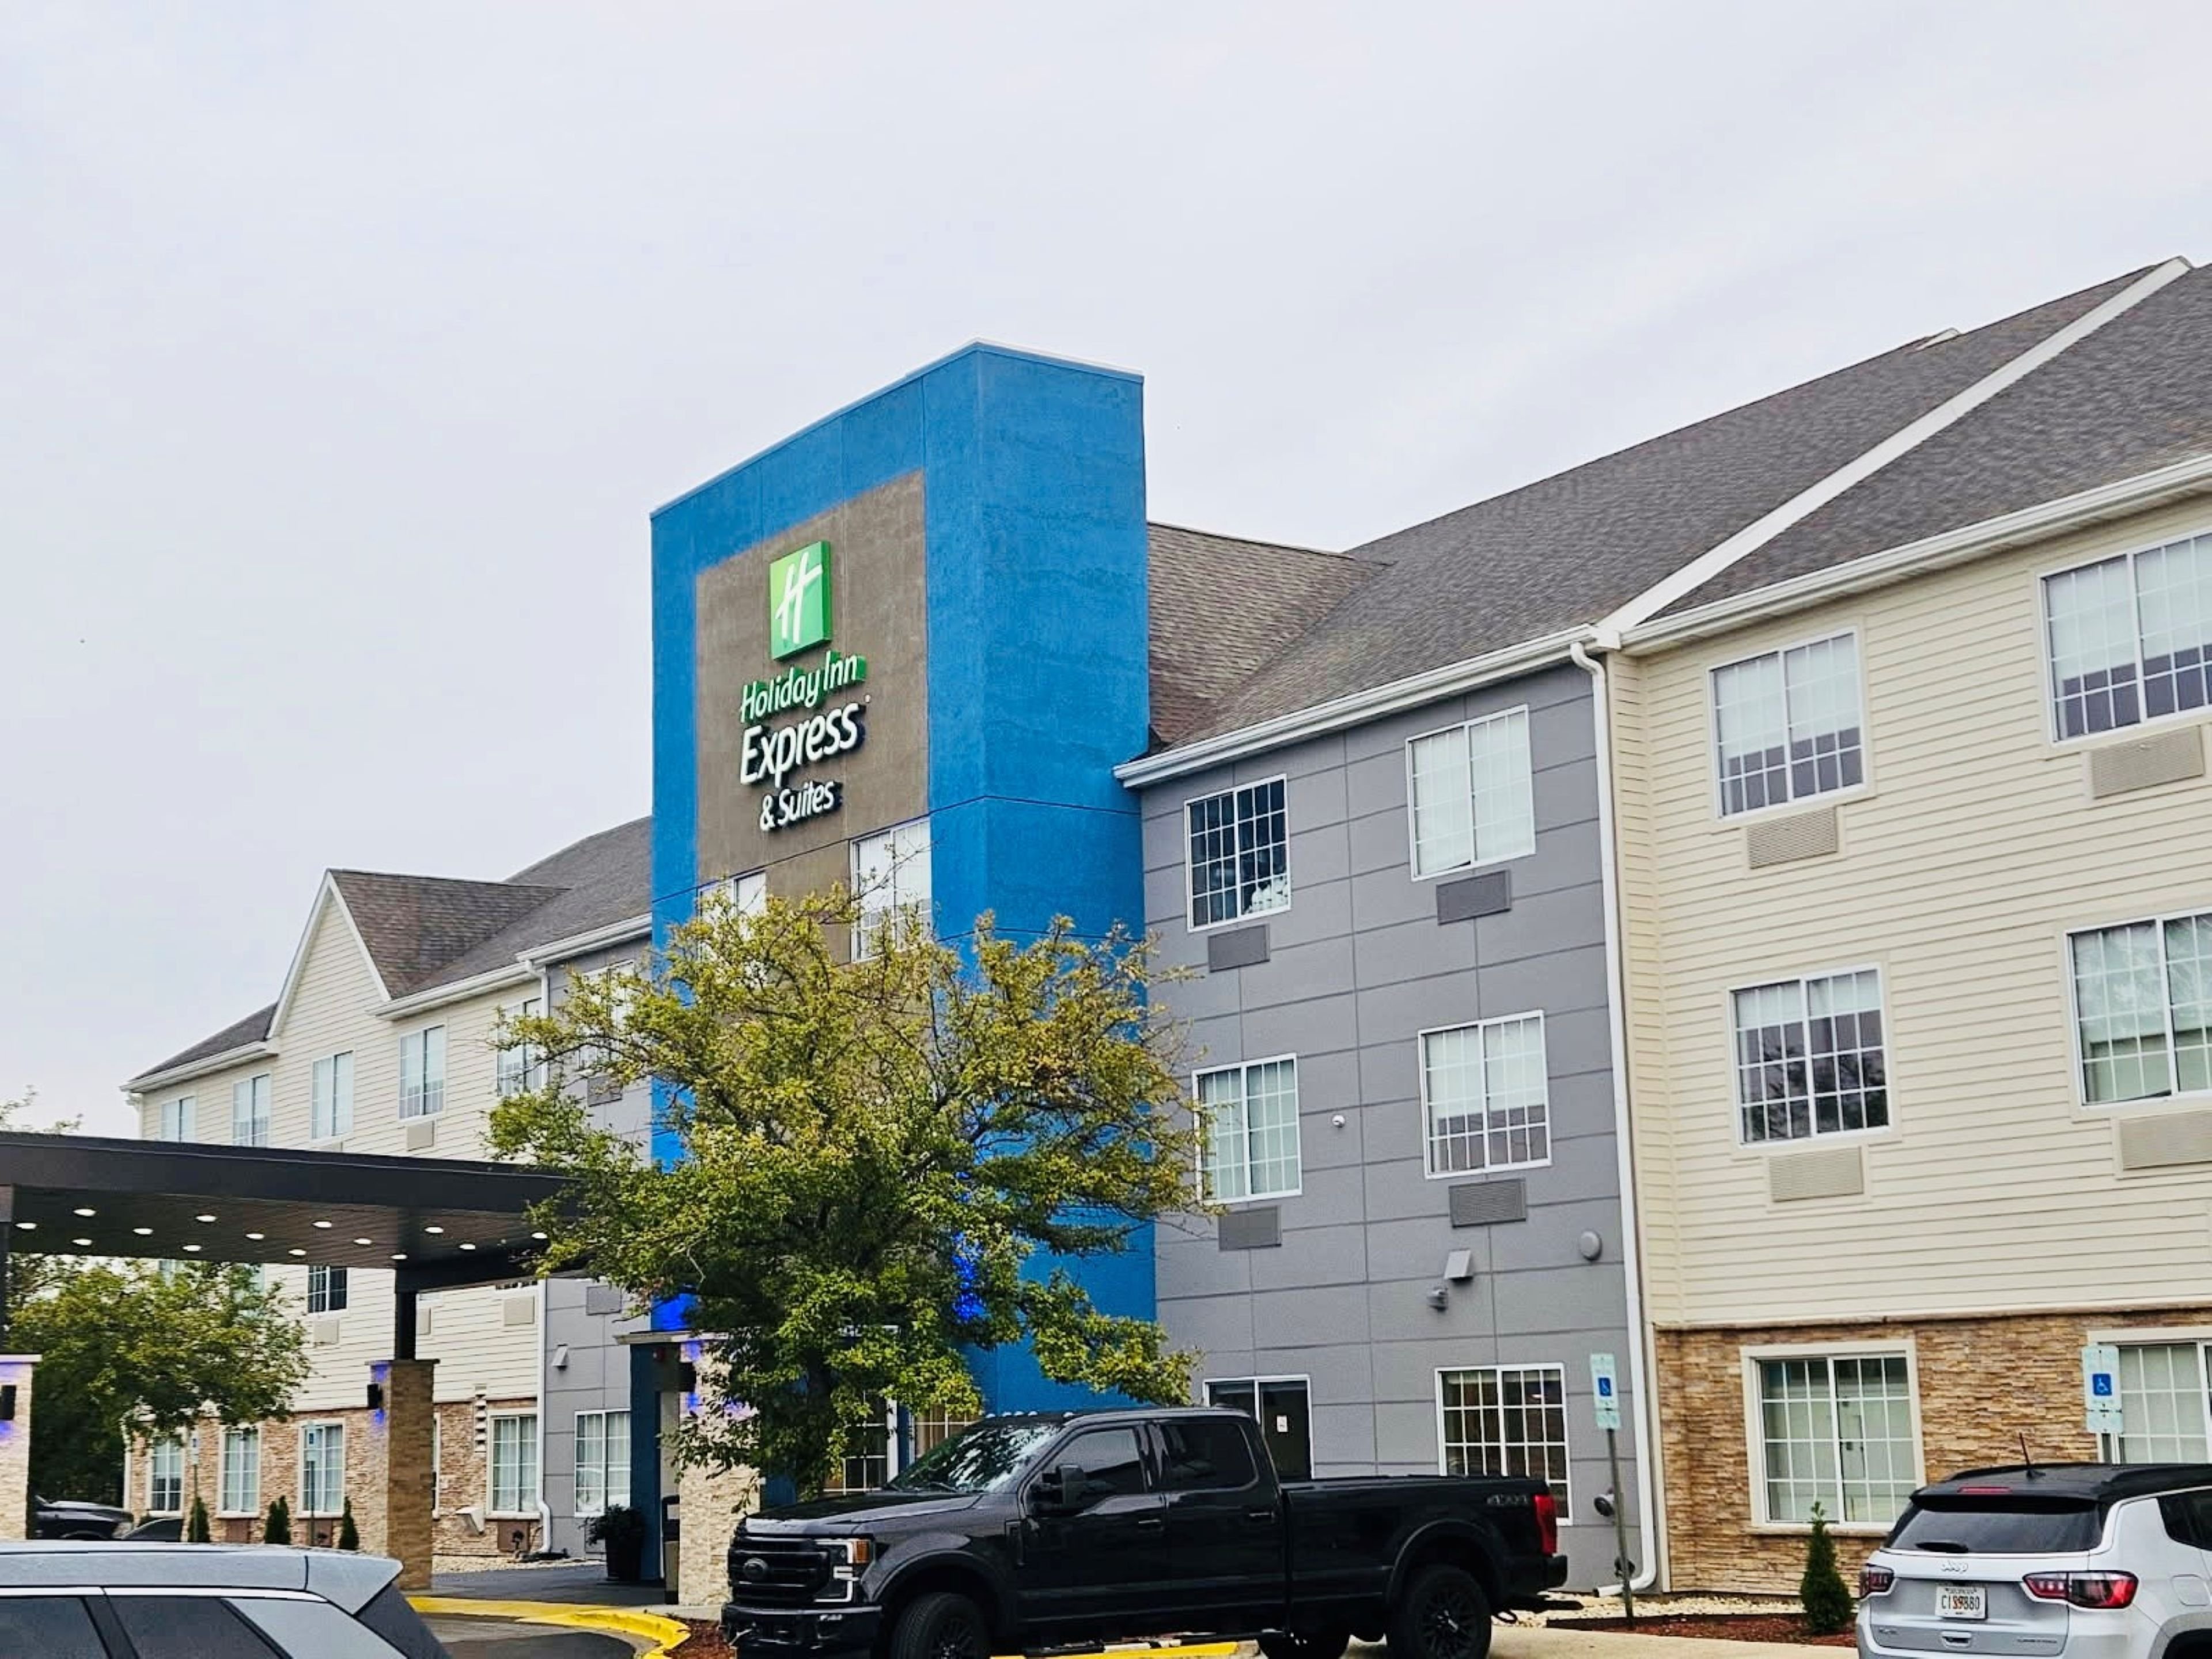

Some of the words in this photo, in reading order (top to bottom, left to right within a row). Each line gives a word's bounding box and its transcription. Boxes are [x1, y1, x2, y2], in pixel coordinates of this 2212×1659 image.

[740, 666, 821, 723] Holiday
[823, 650, 858, 691] Inn
[741, 702, 859, 788] Express
[760, 794, 776, 831] &
[777, 781, 835, 825] Suites
